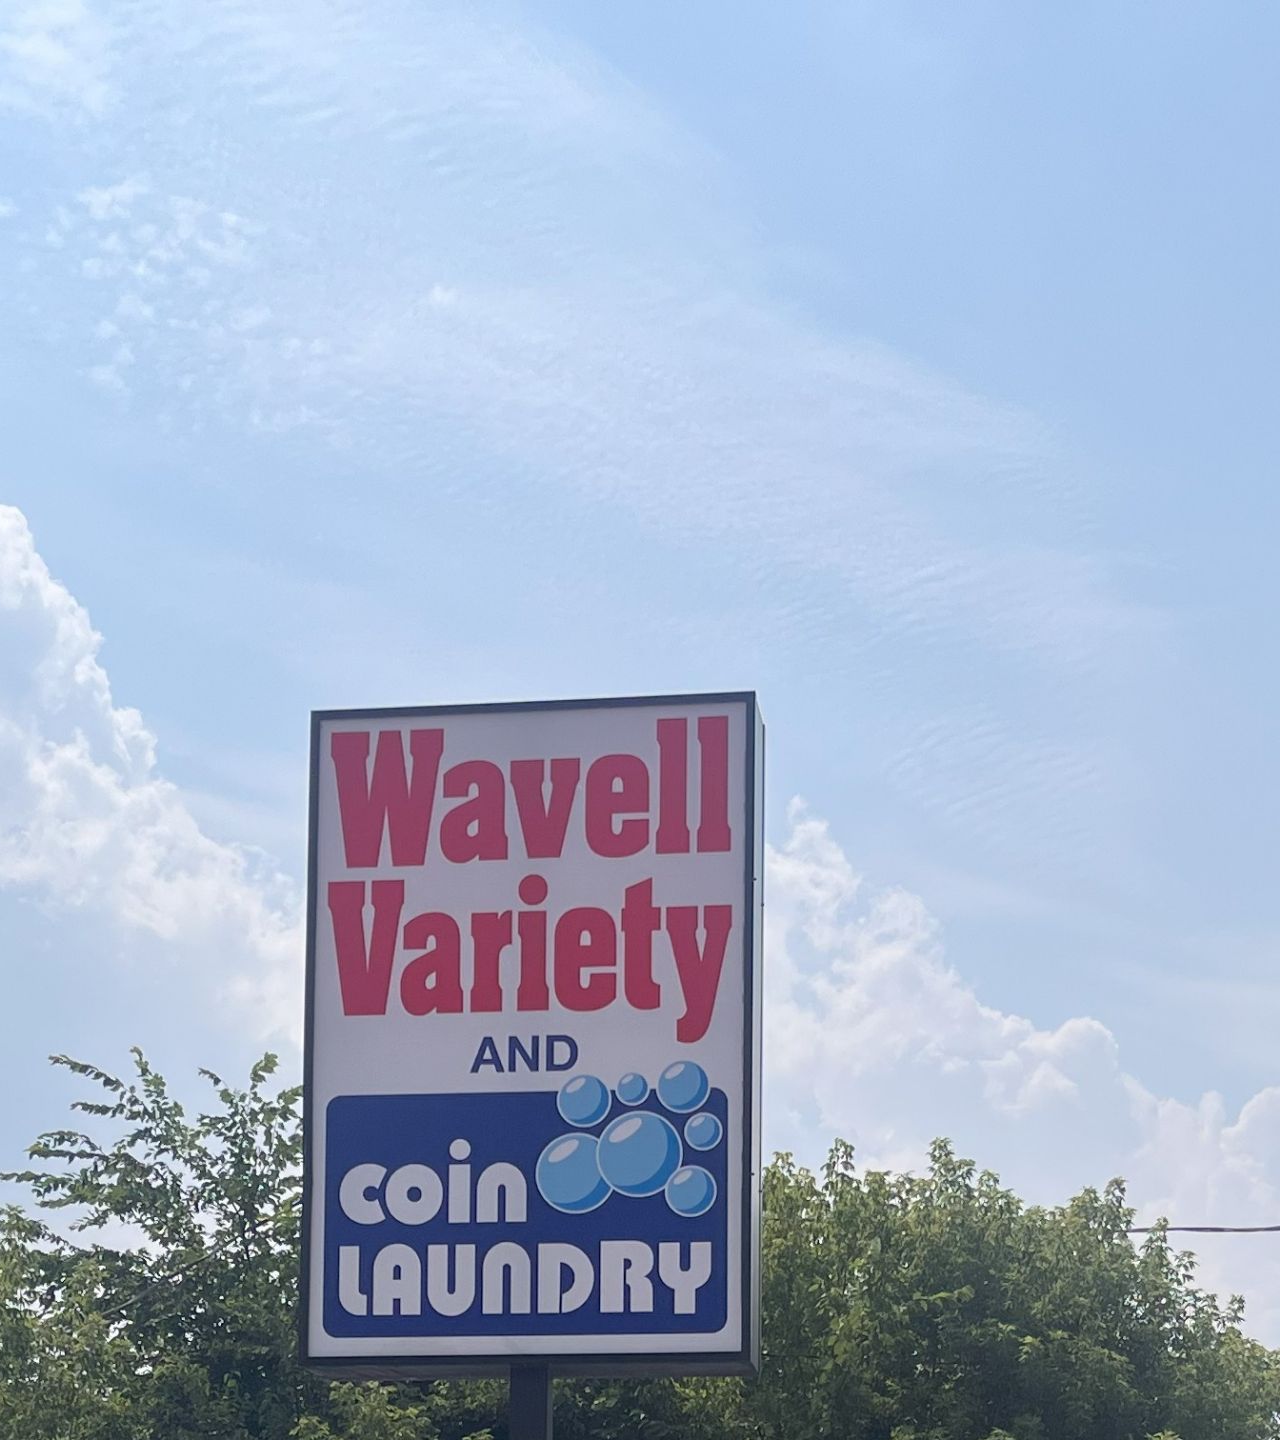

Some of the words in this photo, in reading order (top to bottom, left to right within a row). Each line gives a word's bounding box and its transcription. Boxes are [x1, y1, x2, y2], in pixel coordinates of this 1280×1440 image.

[330, 715, 732, 868] Wavell
[327, 874, 733, 1043] Variety
[470, 1034, 579, 1073] AND
[338, 1239, 712, 1316] LAUNDRY
